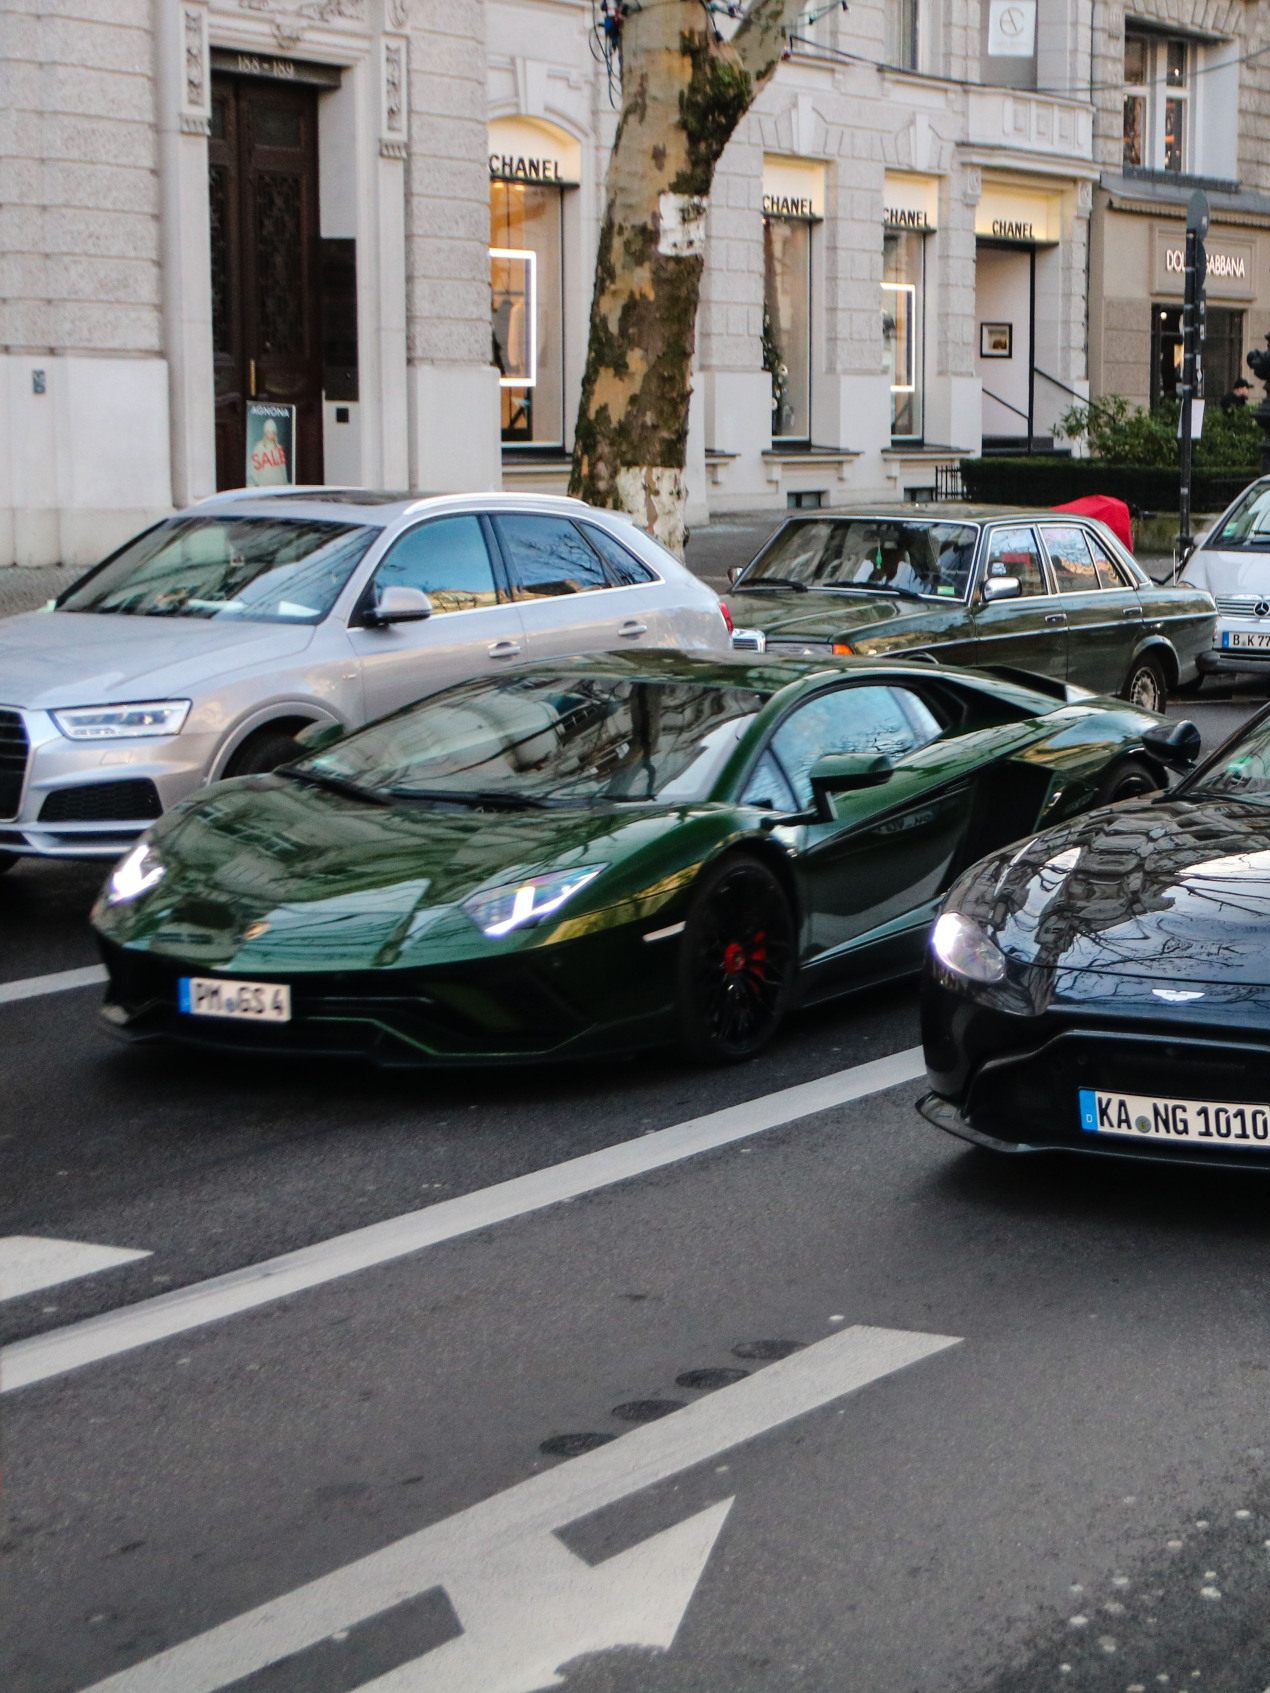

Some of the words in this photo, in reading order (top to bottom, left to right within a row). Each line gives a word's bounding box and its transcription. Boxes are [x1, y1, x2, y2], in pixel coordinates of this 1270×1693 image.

[488, 154, 564, 180] CHANEL
[763, 195, 816, 217] CHANEL
[883, 207, 931, 229] CHANEL
[992, 219, 1035, 238] CHANEL
[251, 405, 290, 418] AGNONA
[251, 446, 287, 471] SALE
[1233, 634, 1240, 646] B
[1247, 635, 1255, 647] K
[194, 983, 222, 1011] PM
[271, 988, 284, 1016] 4
[1086, 1113, 1093, 1123] D
[1097, 1096, 1132, 1130] KA
[1152, 1102, 1189, 1135] NG
[1196, 1106, 1269, 1140] 1010
